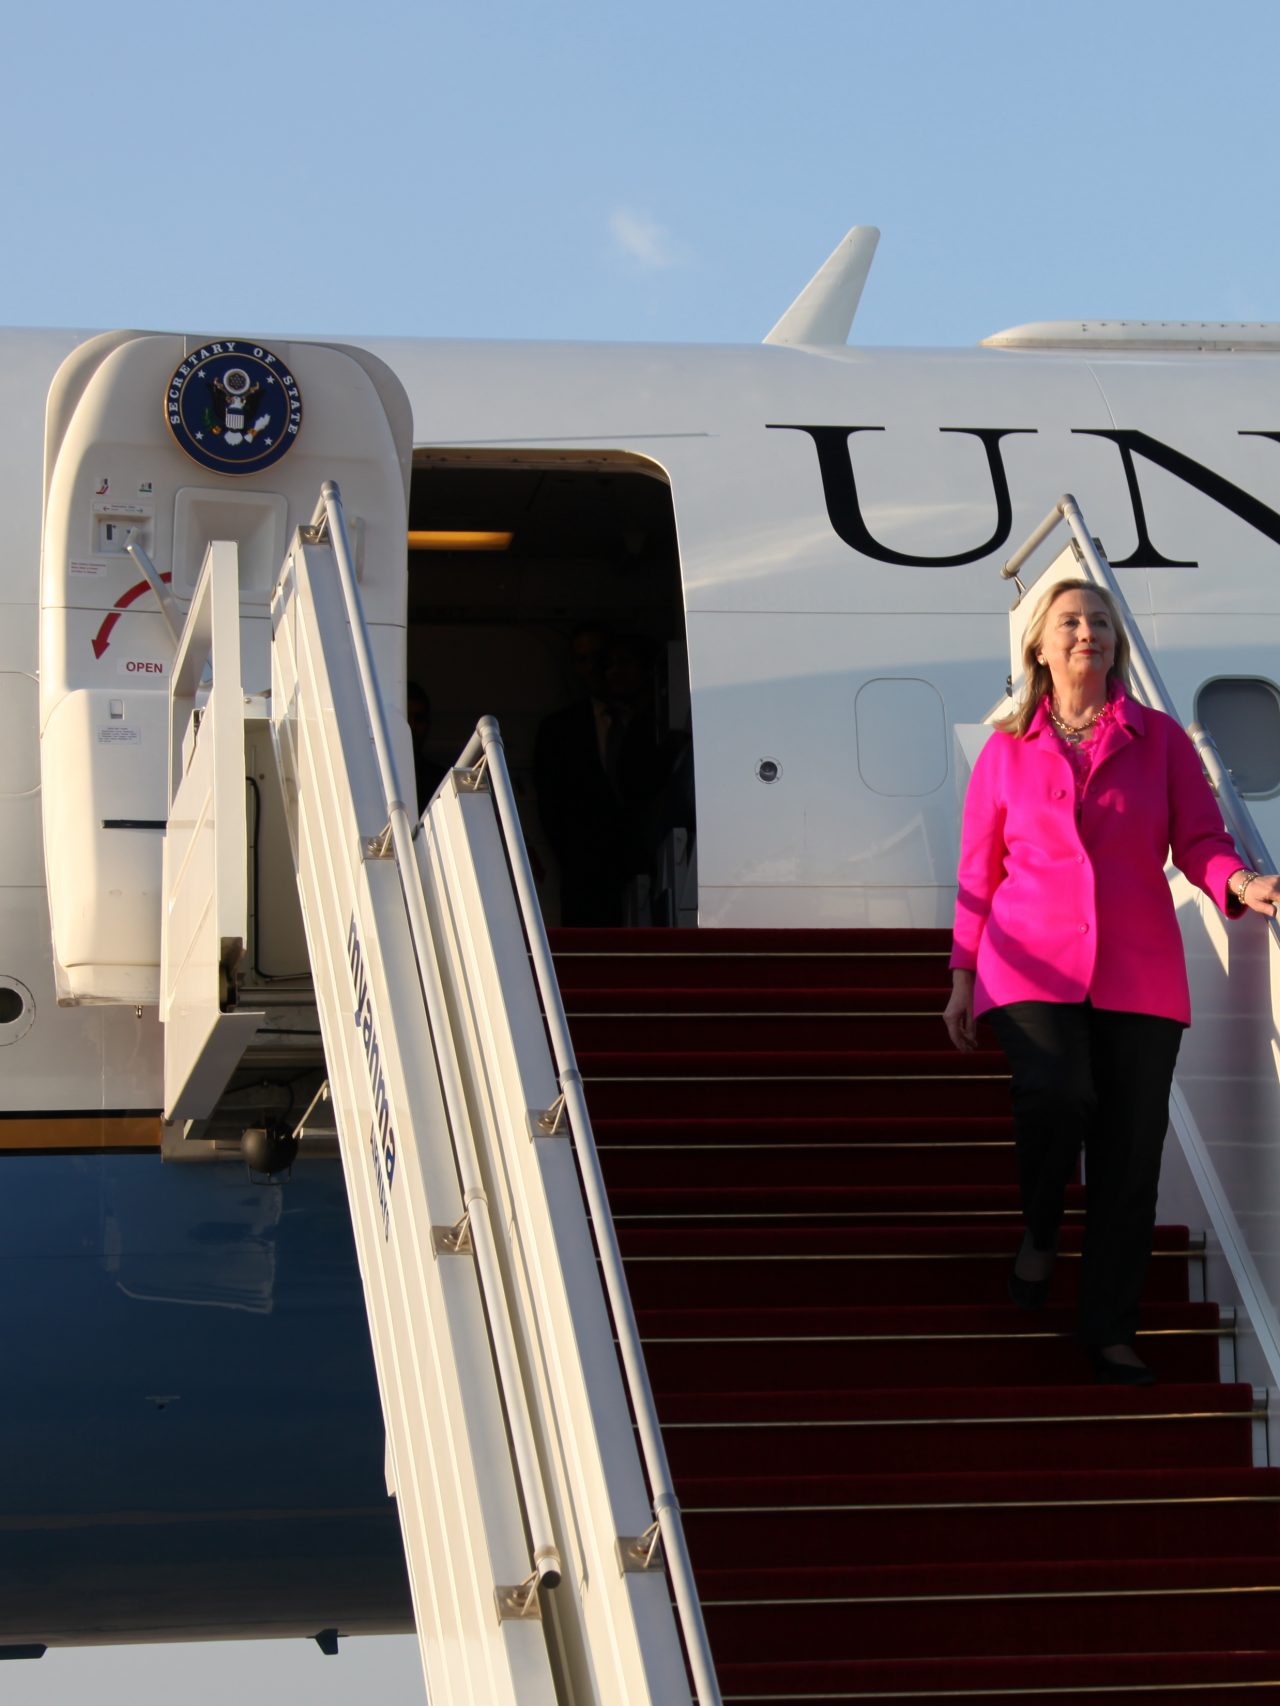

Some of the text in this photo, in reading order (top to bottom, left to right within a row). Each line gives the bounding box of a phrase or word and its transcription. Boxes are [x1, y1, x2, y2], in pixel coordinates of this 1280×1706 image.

[168, 342, 301, 435] SECRETARY OF STATE
[126, 661, 163, 674] OPEN
[347, 908, 396, 1192] myanma
